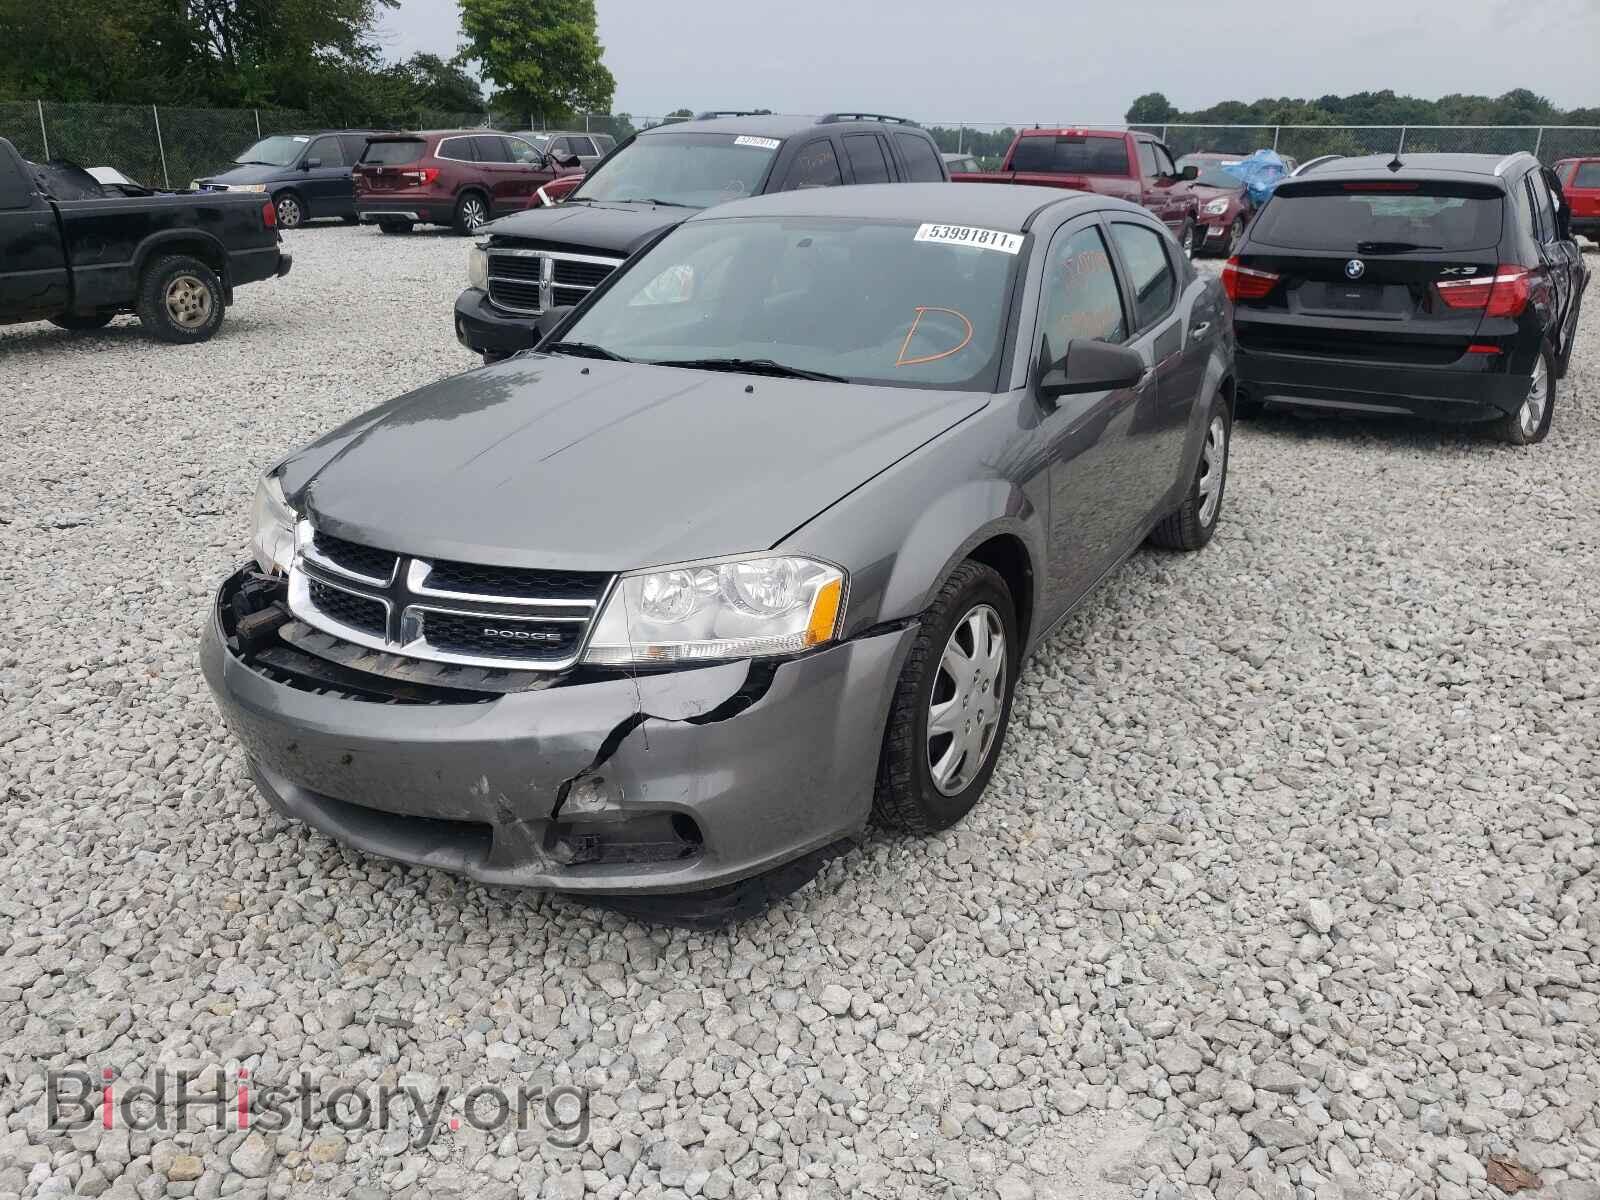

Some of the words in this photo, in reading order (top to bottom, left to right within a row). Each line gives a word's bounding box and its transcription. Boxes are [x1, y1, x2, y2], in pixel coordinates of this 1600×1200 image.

[1440, 266, 1478, 275] X3
[896, 306, 973, 366] D
[484, 628, 561, 641] DODGE
